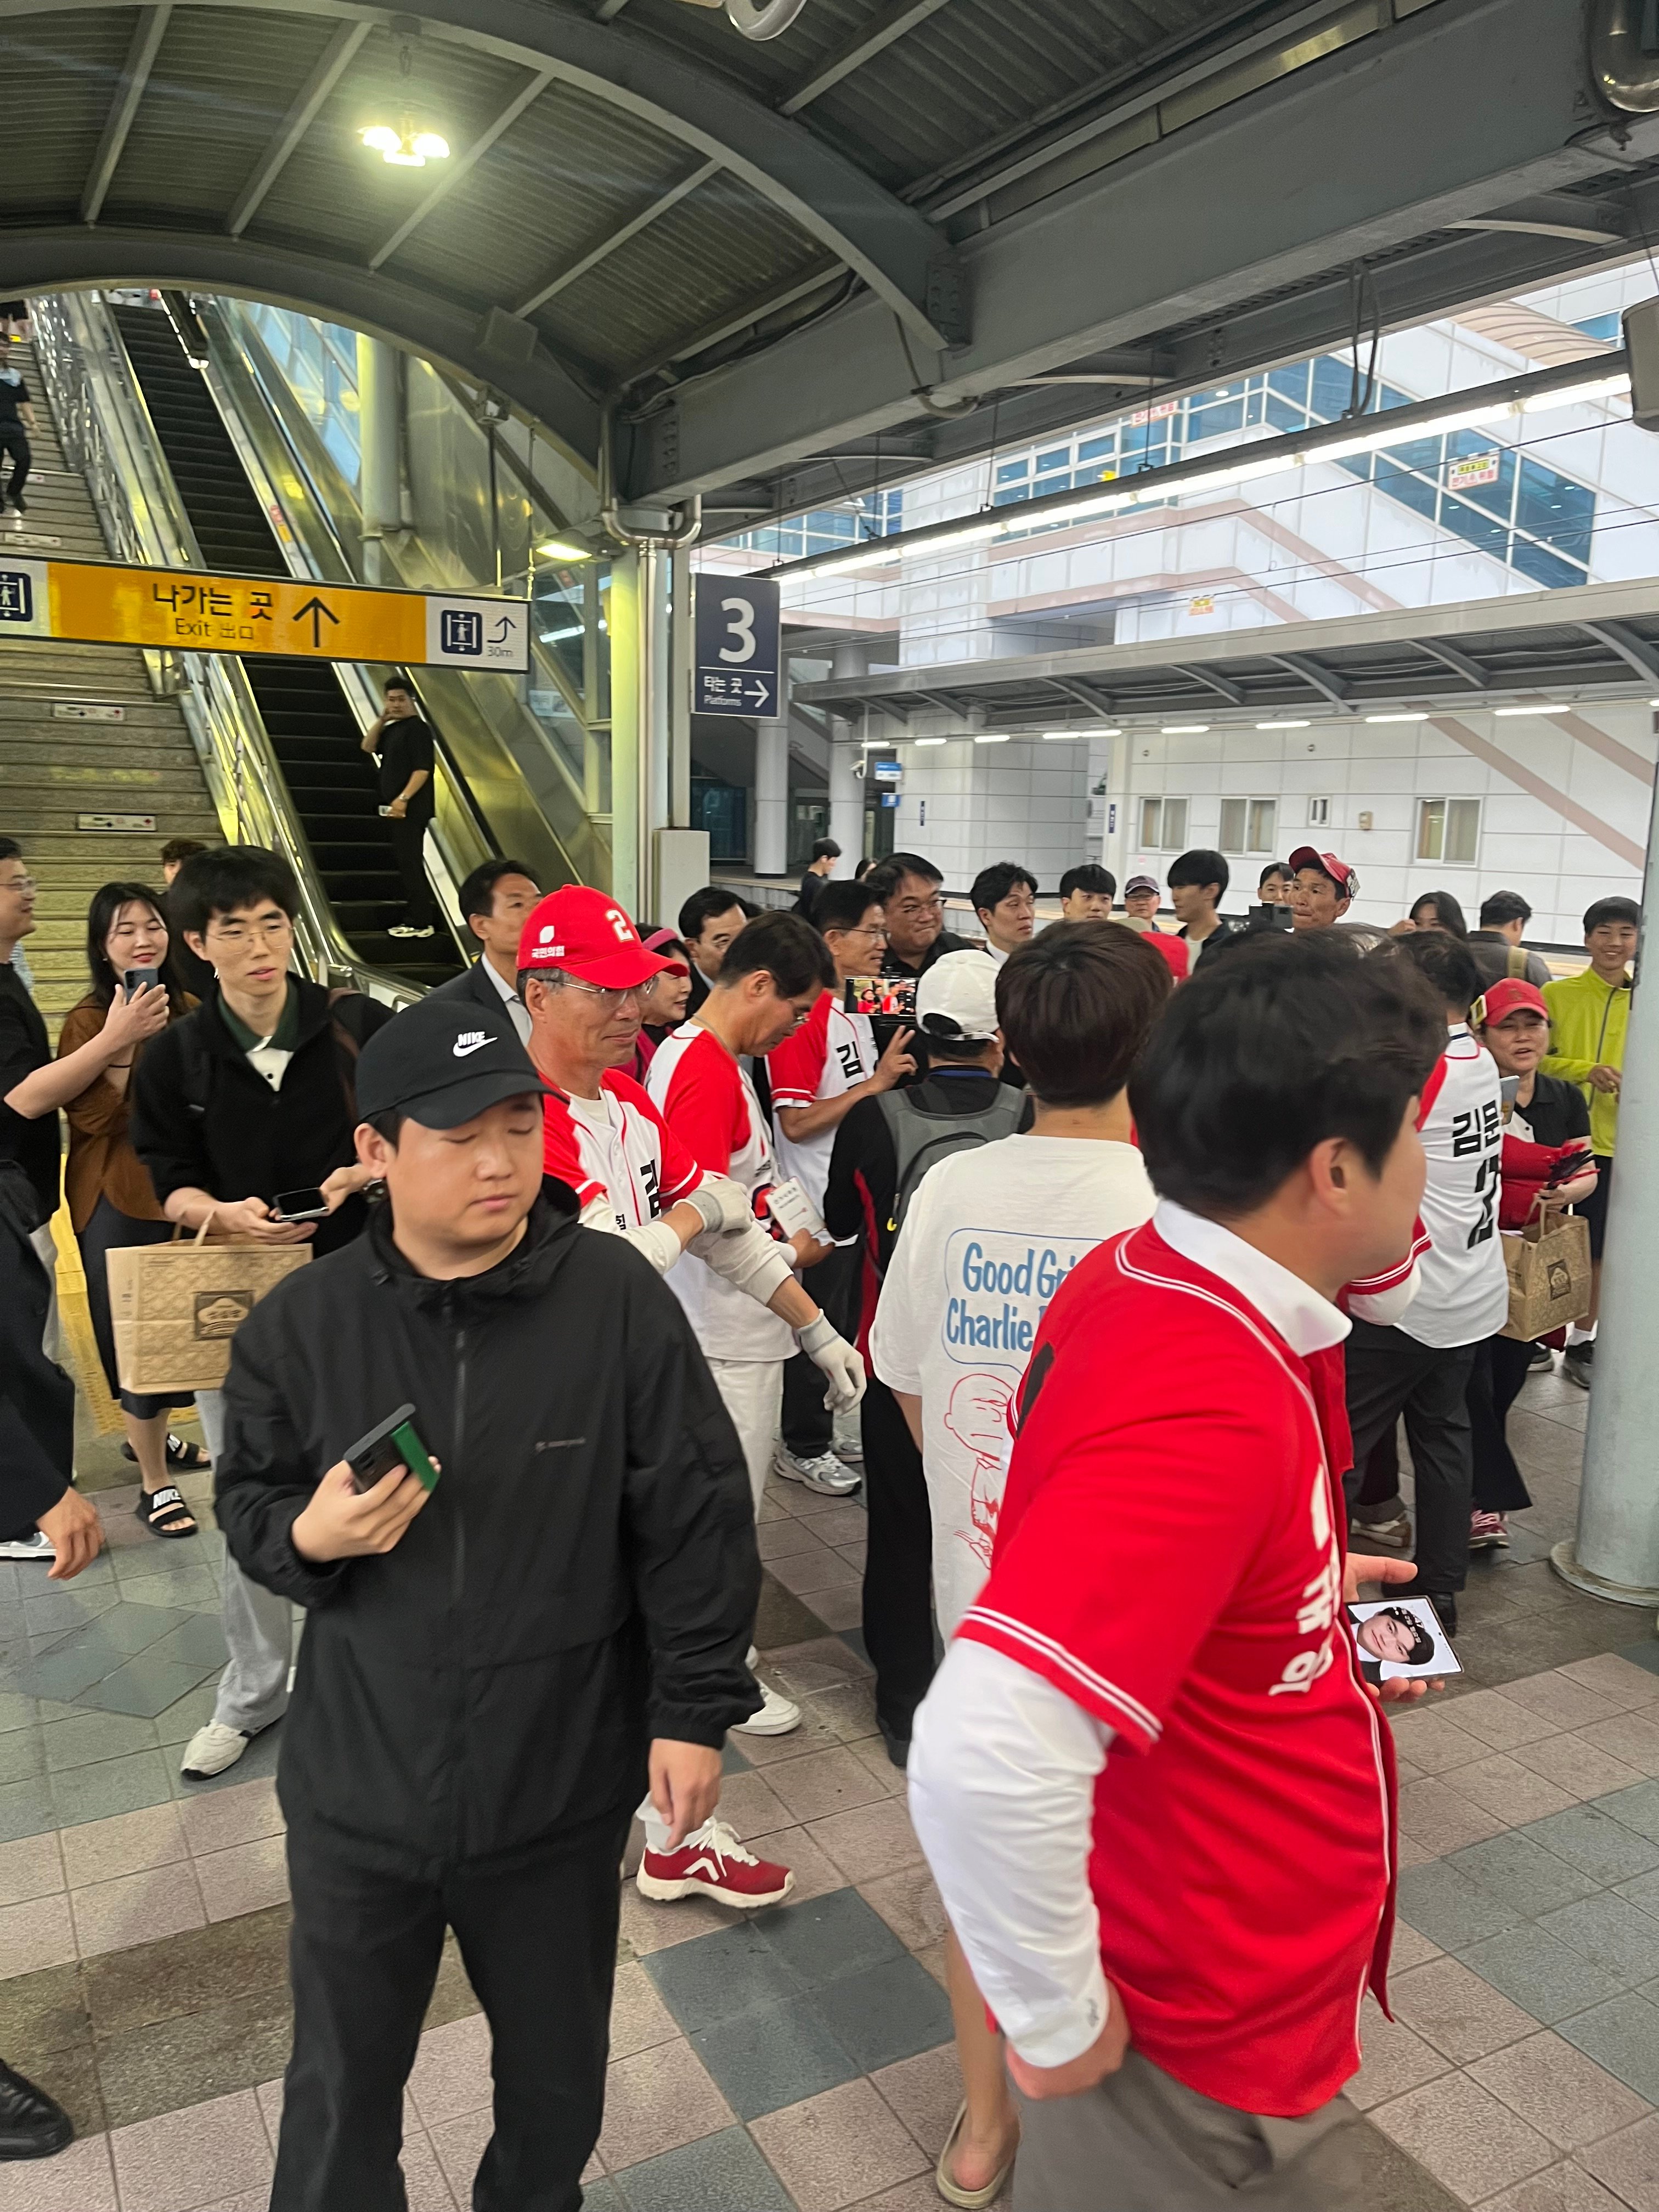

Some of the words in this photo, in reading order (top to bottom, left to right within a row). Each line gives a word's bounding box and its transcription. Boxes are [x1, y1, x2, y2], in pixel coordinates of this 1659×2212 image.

[153, 583, 232, 617] 나가는
[250, 591, 273, 621] 곳
[175, 618, 211, 637] Exit
[221, 622, 254, 640] 出口
[718, 597, 757, 663] 3
[487, 646, 514, 657] 30m
[704, 675, 726, 692] 타는
[730, 678, 742, 694] 곳
[605, 908, 635, 943] 2
[531, 945, 565, 959] 국민의힘
[458, 1031, 486, 1047] NIKE
[963, 1242, 1035, 1296] Good
[946, 1297, 1034, 1352] Charlie
